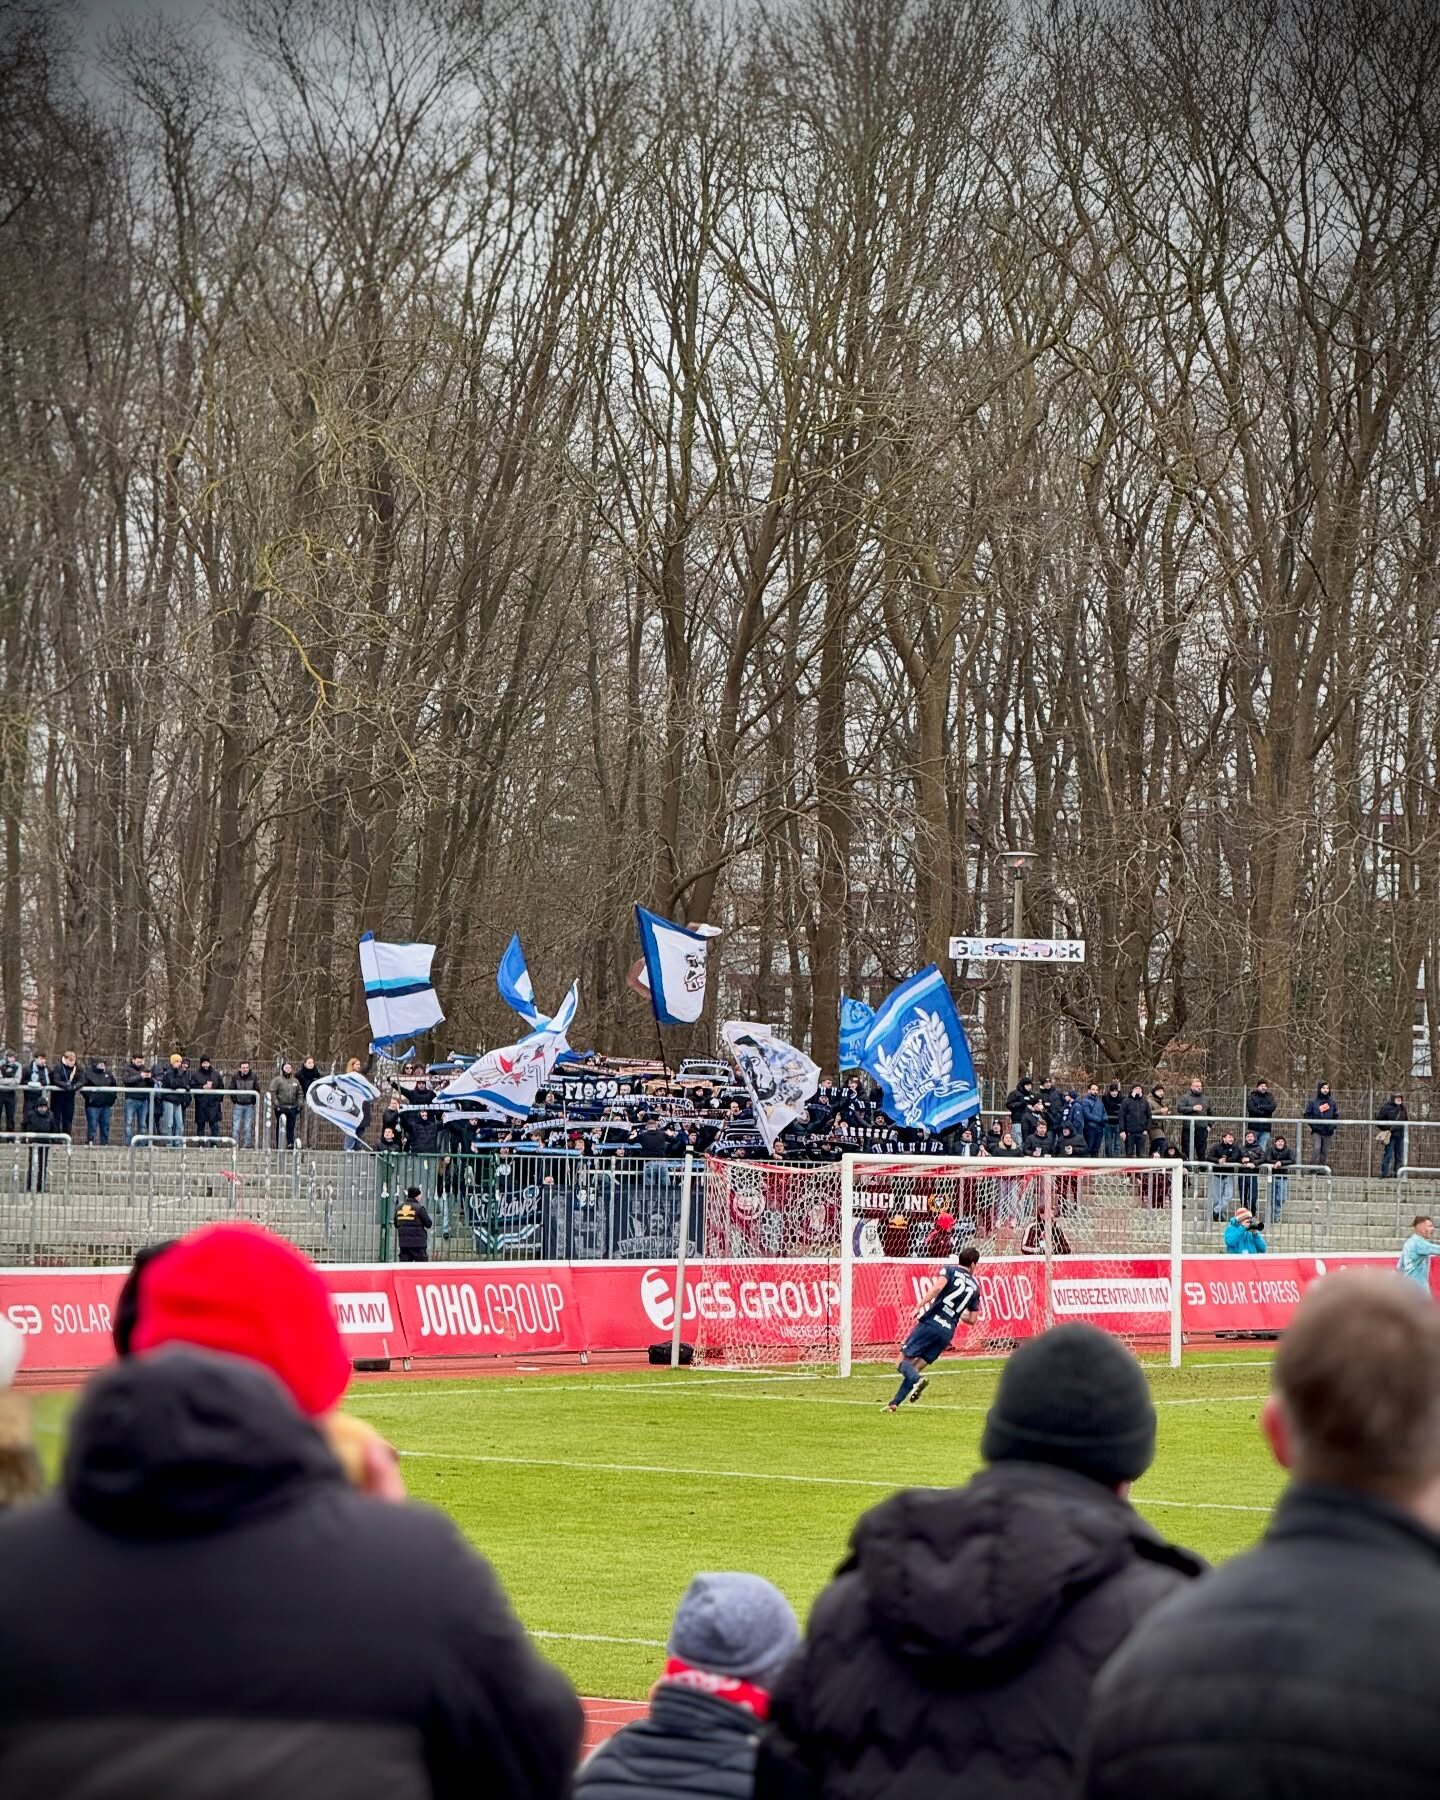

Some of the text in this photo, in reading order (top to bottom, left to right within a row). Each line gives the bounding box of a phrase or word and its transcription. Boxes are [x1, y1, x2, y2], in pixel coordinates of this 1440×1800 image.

[1053, 1285, 1148, 1306] WERBEZENTRUM
[1210, 1280, 1249, 1304] SOLAR
[1250, 1280, 1300, 1303] EXPRESS
[51, 1303, 113, 1334] SOLAR
[361, 1303, 385, 1323] MV
[416, 1283, 564, 1336] JOHO.GROUP
